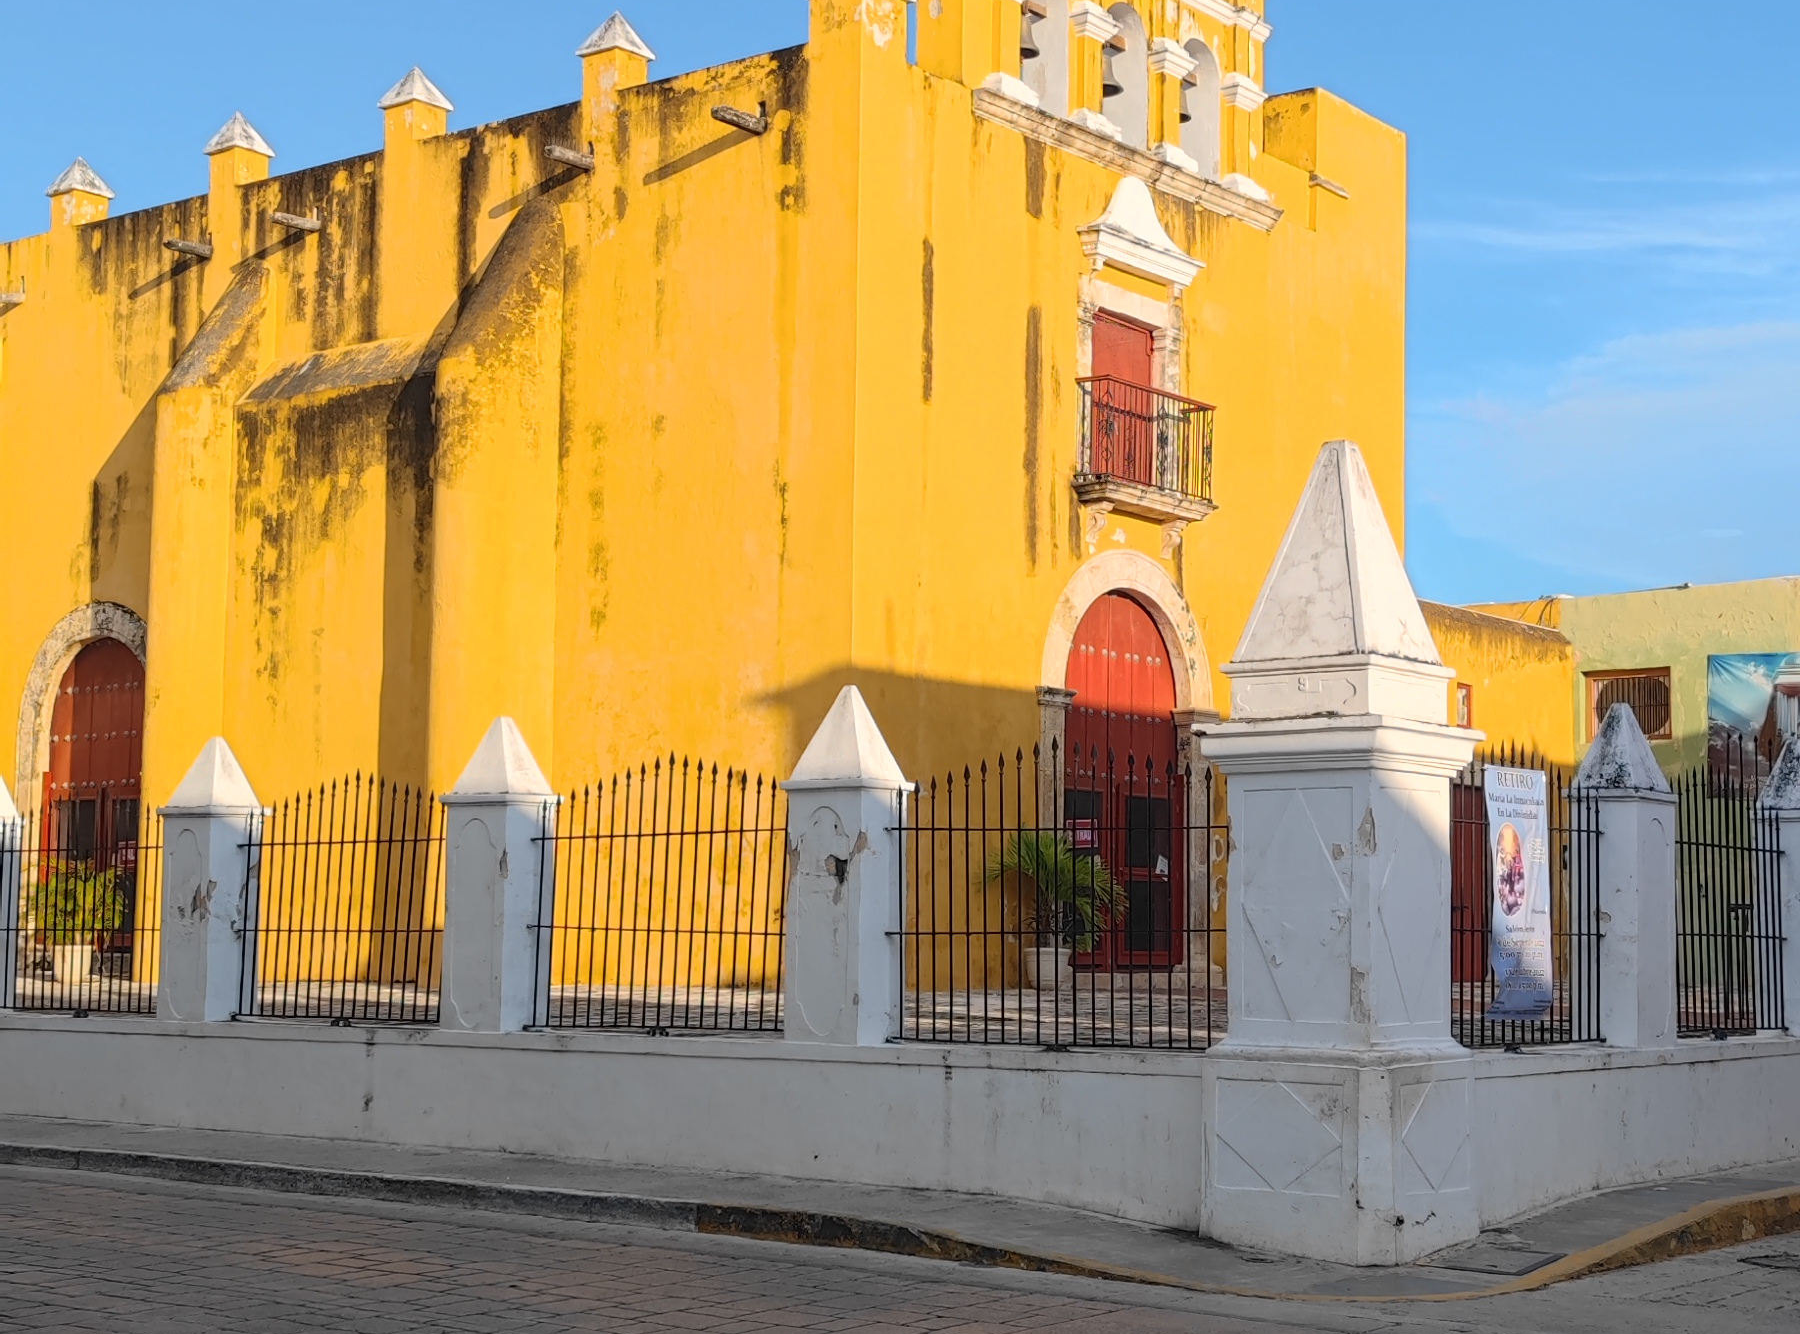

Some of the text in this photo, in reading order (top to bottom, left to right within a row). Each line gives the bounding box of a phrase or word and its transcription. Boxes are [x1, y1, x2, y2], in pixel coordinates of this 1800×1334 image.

[1497, 772, 1533, 790] RETIRO
[1506, 794, 1513, 804] La
[1497, 807, 1504, 817] En
[1505, 808, 1512, 818] La
